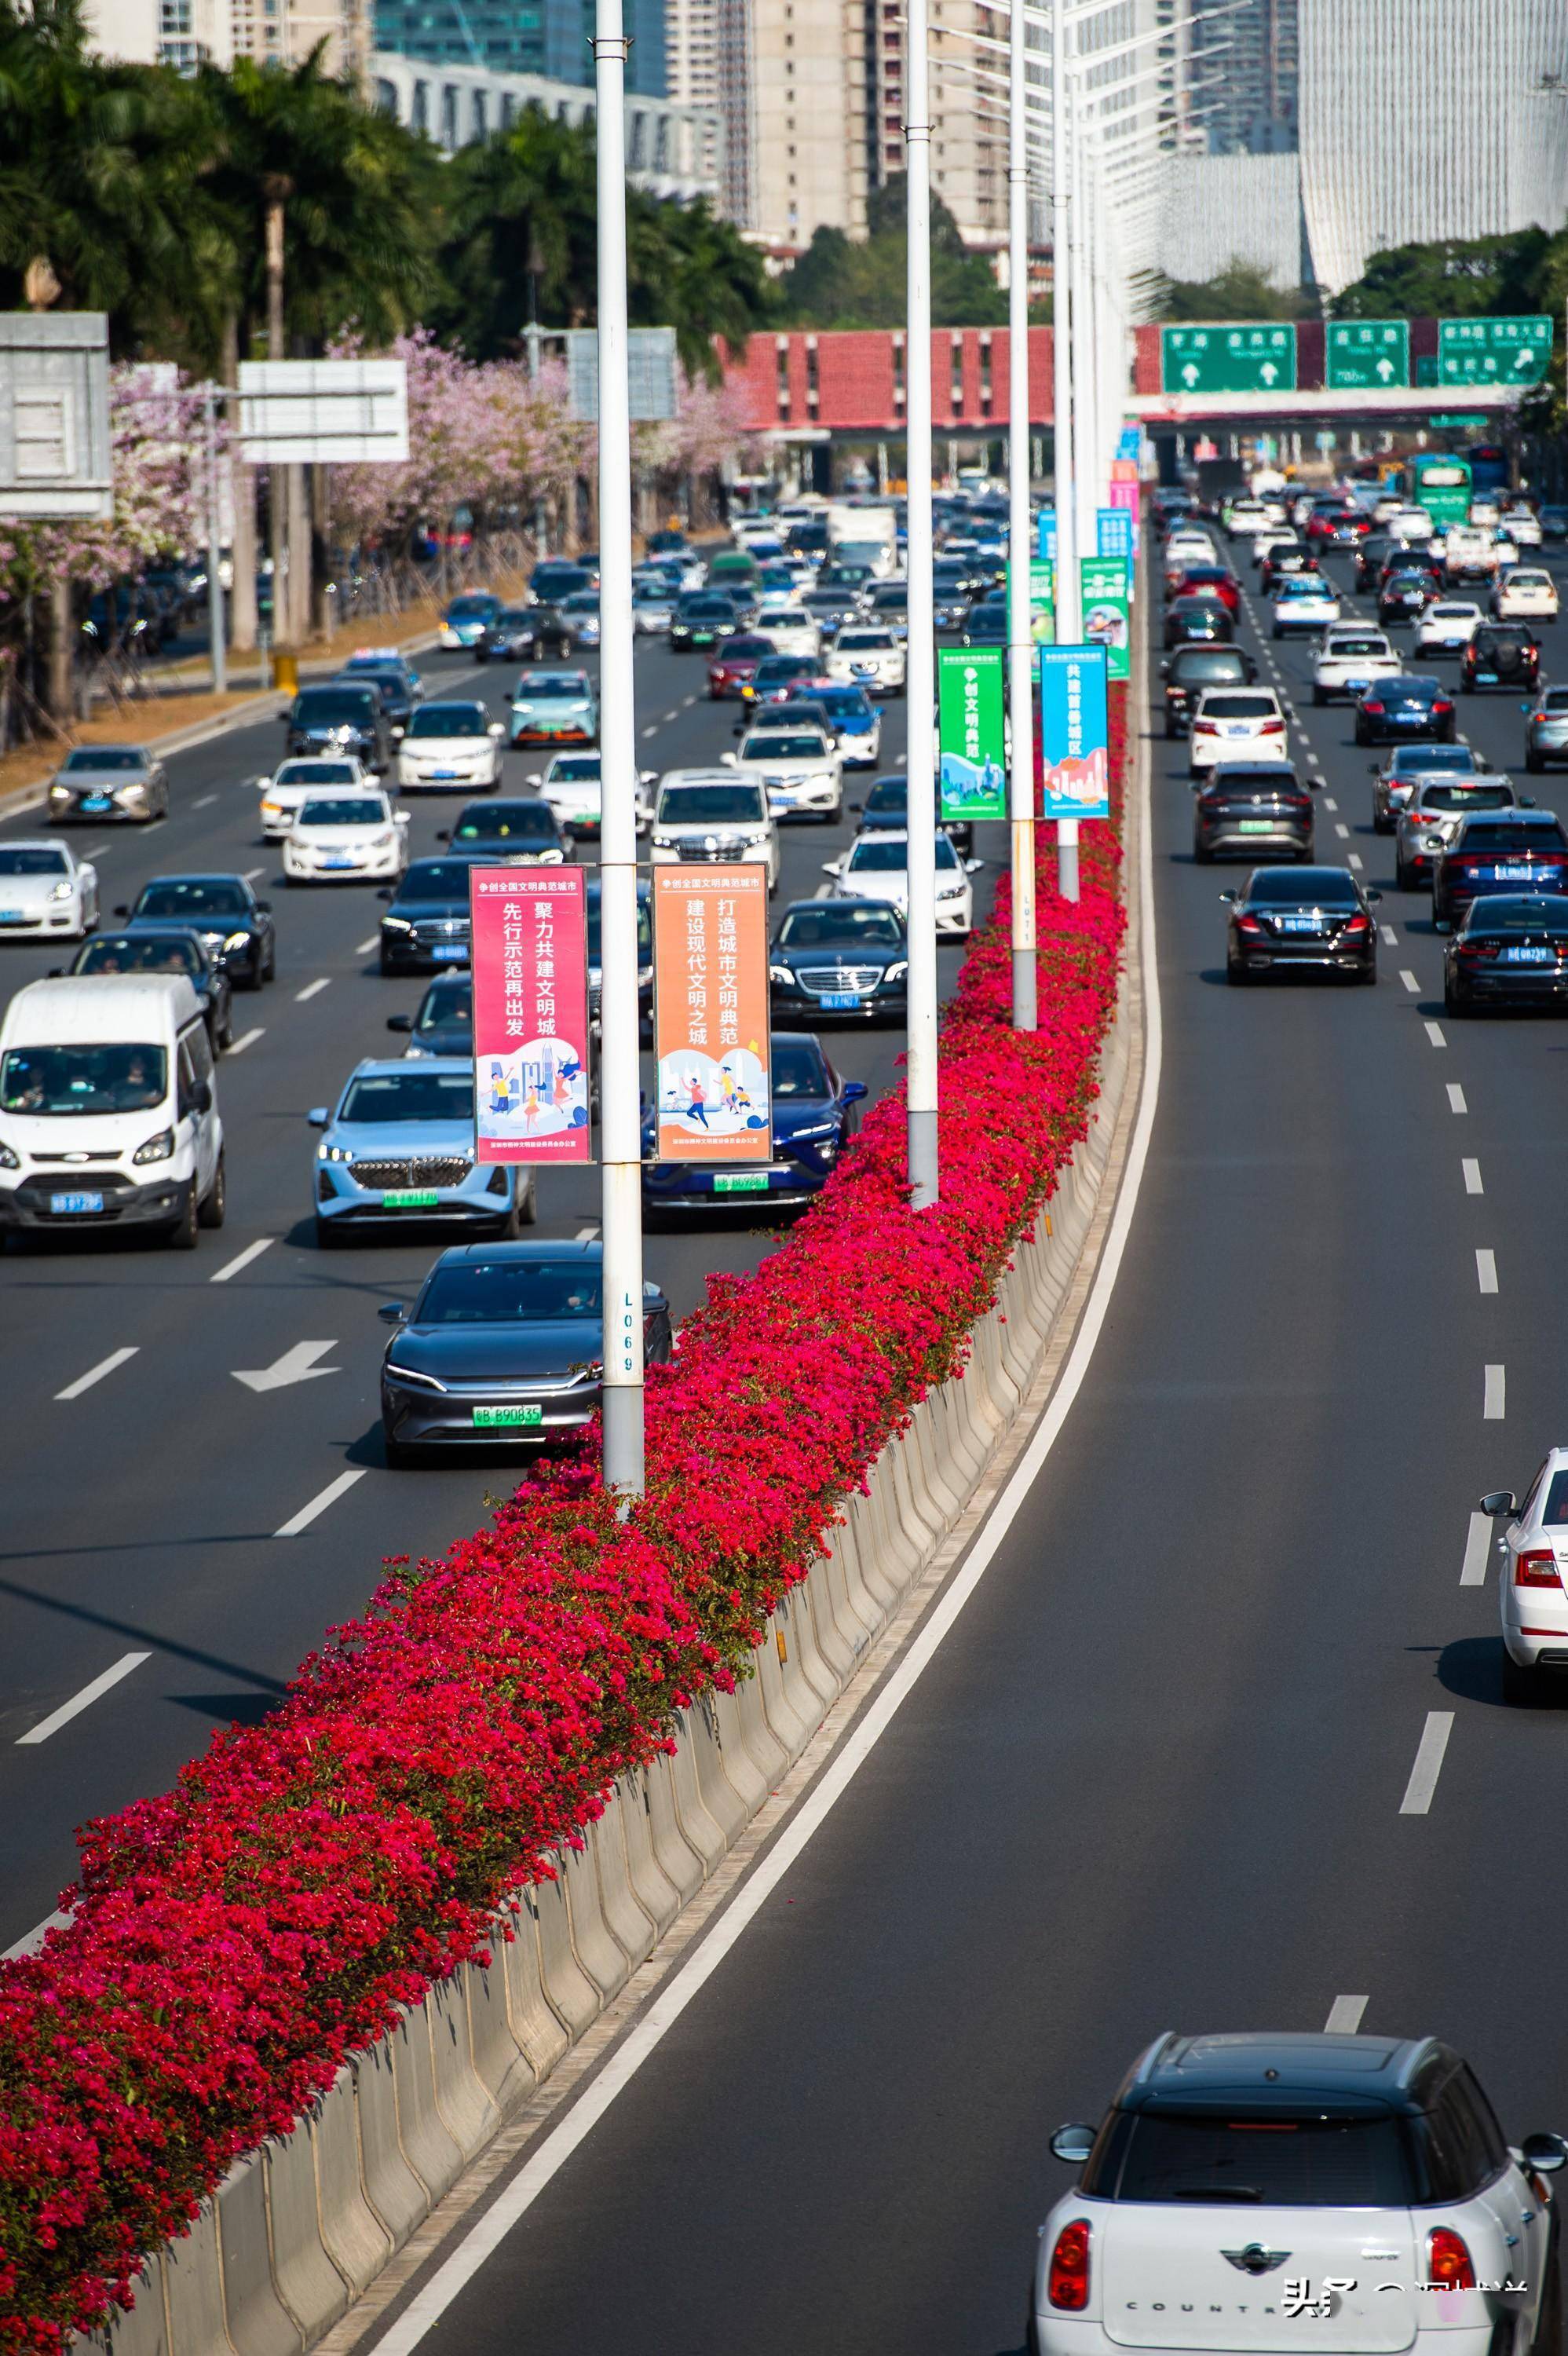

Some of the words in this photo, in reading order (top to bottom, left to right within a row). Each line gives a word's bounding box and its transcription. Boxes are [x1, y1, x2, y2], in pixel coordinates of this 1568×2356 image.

[963, 667, 979, 758] 争创文明典范
[478, 882, 577, 893] 争创全国文明典范城市
[662, 878, 760, 889] 争创全国文明典范城市
[503, 903, 524, 1037] 先行示范再出发
[534, 902, 556, 1036] 聚力共建文明城
[686, 899, 707, 1045] 建设现代文明之城
[717, 898, 739, 1044] 打造城市文明典范
[624, 1293, 633, 1370] L069
